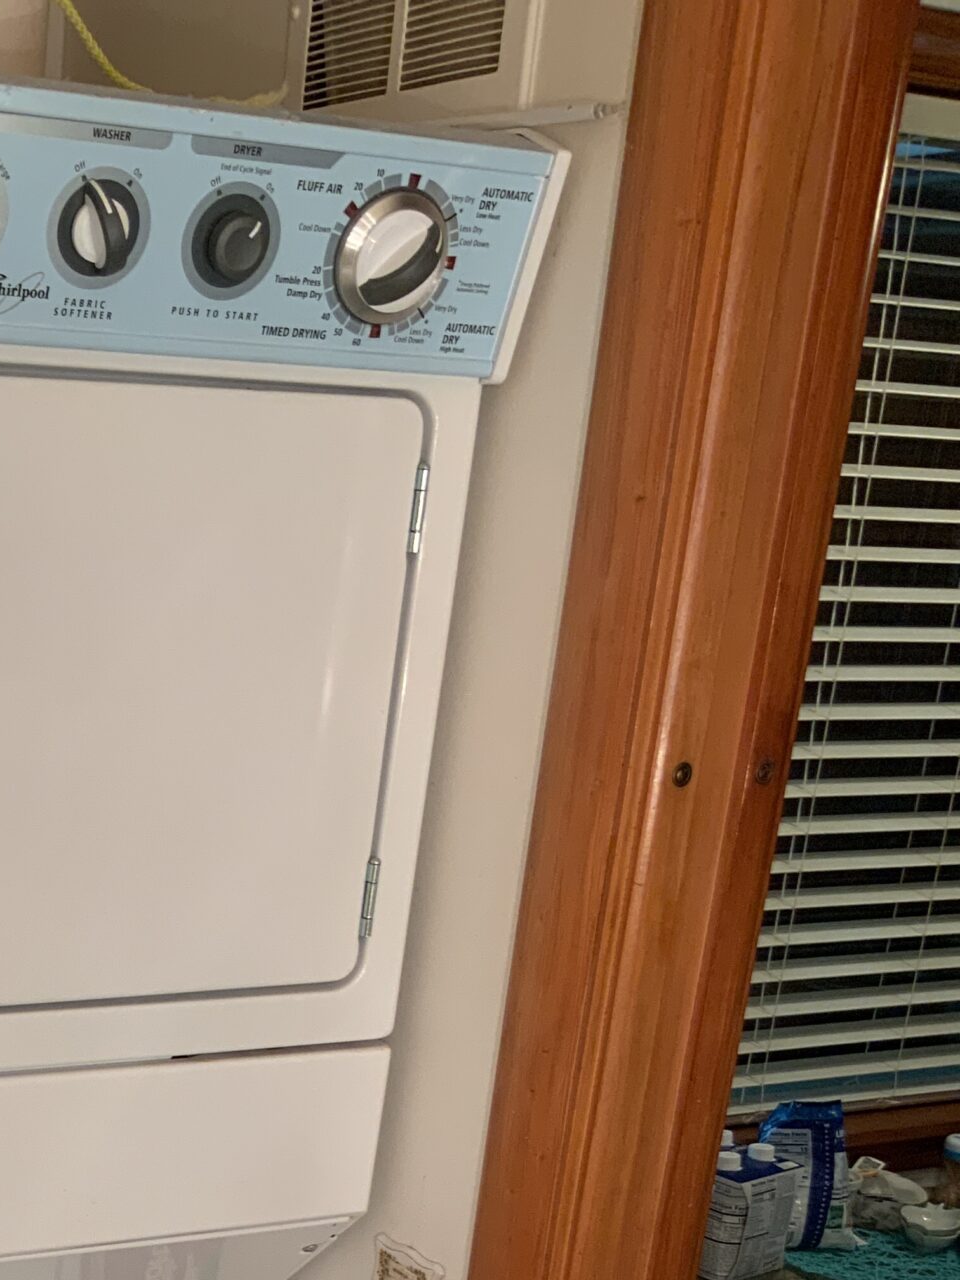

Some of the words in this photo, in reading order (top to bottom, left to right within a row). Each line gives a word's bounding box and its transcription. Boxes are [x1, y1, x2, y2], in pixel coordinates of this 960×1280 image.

[92, 127, 132, 142] WASHER
[233, 144, 263, 157] DRYER
[74, 160, 86, 173] Off
[377, 169, 385, 178] 10
[210, 176, 221, 187] Off
[297, 179, 326, 193] FLUFF
[326, 183, 344, 195] AIR
[354, 182, 364, 191] 20
[481, 187, 534, 202] AUTOMATIC
[479, 200, 498, 211] DRY
[298, 222, 312, 232] Cool
[313, 224, 331, 233] Down
[312, 266, 322, 275] 20
[275, 274, 301, 285] Tumble
[302, 277, 321, 287] Press
[286, 288, 308, 299] Damp
[309, 290, 323, 301] Dry
[64, 297, 106, 309] FABRIC
[53, 307, 113, 320] SOFTENER
[171, 306, 200, 317] PUSH
[206, 309, 219, 318] TO
[225, 311, 259, 322] START
[321, 312, 331, 321] 40
[261, 325, 290, 337] TIMED
[292, 328, 327, 340] DRYING
[333, 327, 343, 337] 50
[445, 323, 496, 336] AUTOMATIC
[442, 335, 460, 345] DRY
